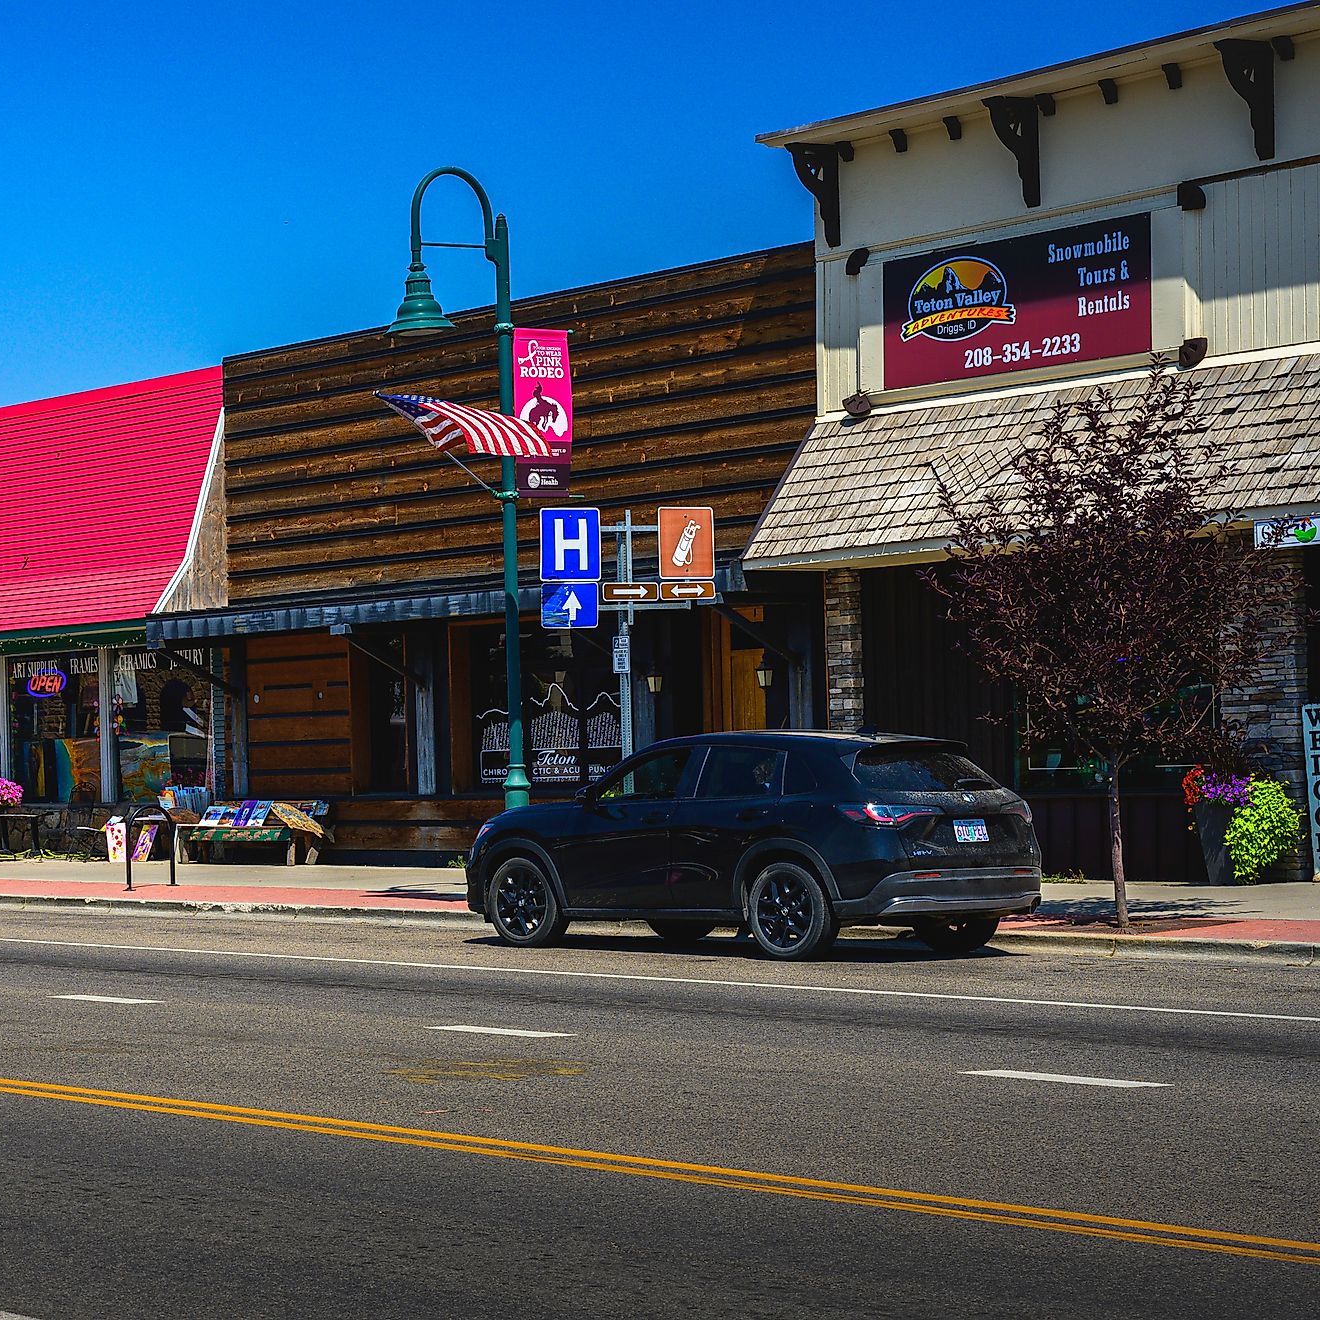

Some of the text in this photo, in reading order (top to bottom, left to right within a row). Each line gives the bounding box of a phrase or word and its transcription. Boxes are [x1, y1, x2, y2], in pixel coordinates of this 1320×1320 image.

[1048, 231, 1129, 263] Snowmobile
[1077, 260, 1130, 287] Tours &
[914, 289, 1002, 314] Teton Valley
[1077, 291, 1130, 317] Rentals
[911, 309, 1004, 332] ADVENTURES
[937, 320, 977, 335] Driggs, ID
[964, 332, 1081, 369] 208-354-2233
[535, 356, 562, 368] PINK
[519, 366, 565, 379] RODEO
[554, 519, 588, 571] H
[614, 639, 619, 648] 2
[12, 660, 58, 679] ART SUPPLIES
[70, 656, 99, 675] FRAMES
[118, 652, 157, 670] CERAMICS
[30, 675, 62, 693] OPEN
[536, 749, 577, 766] Teton
